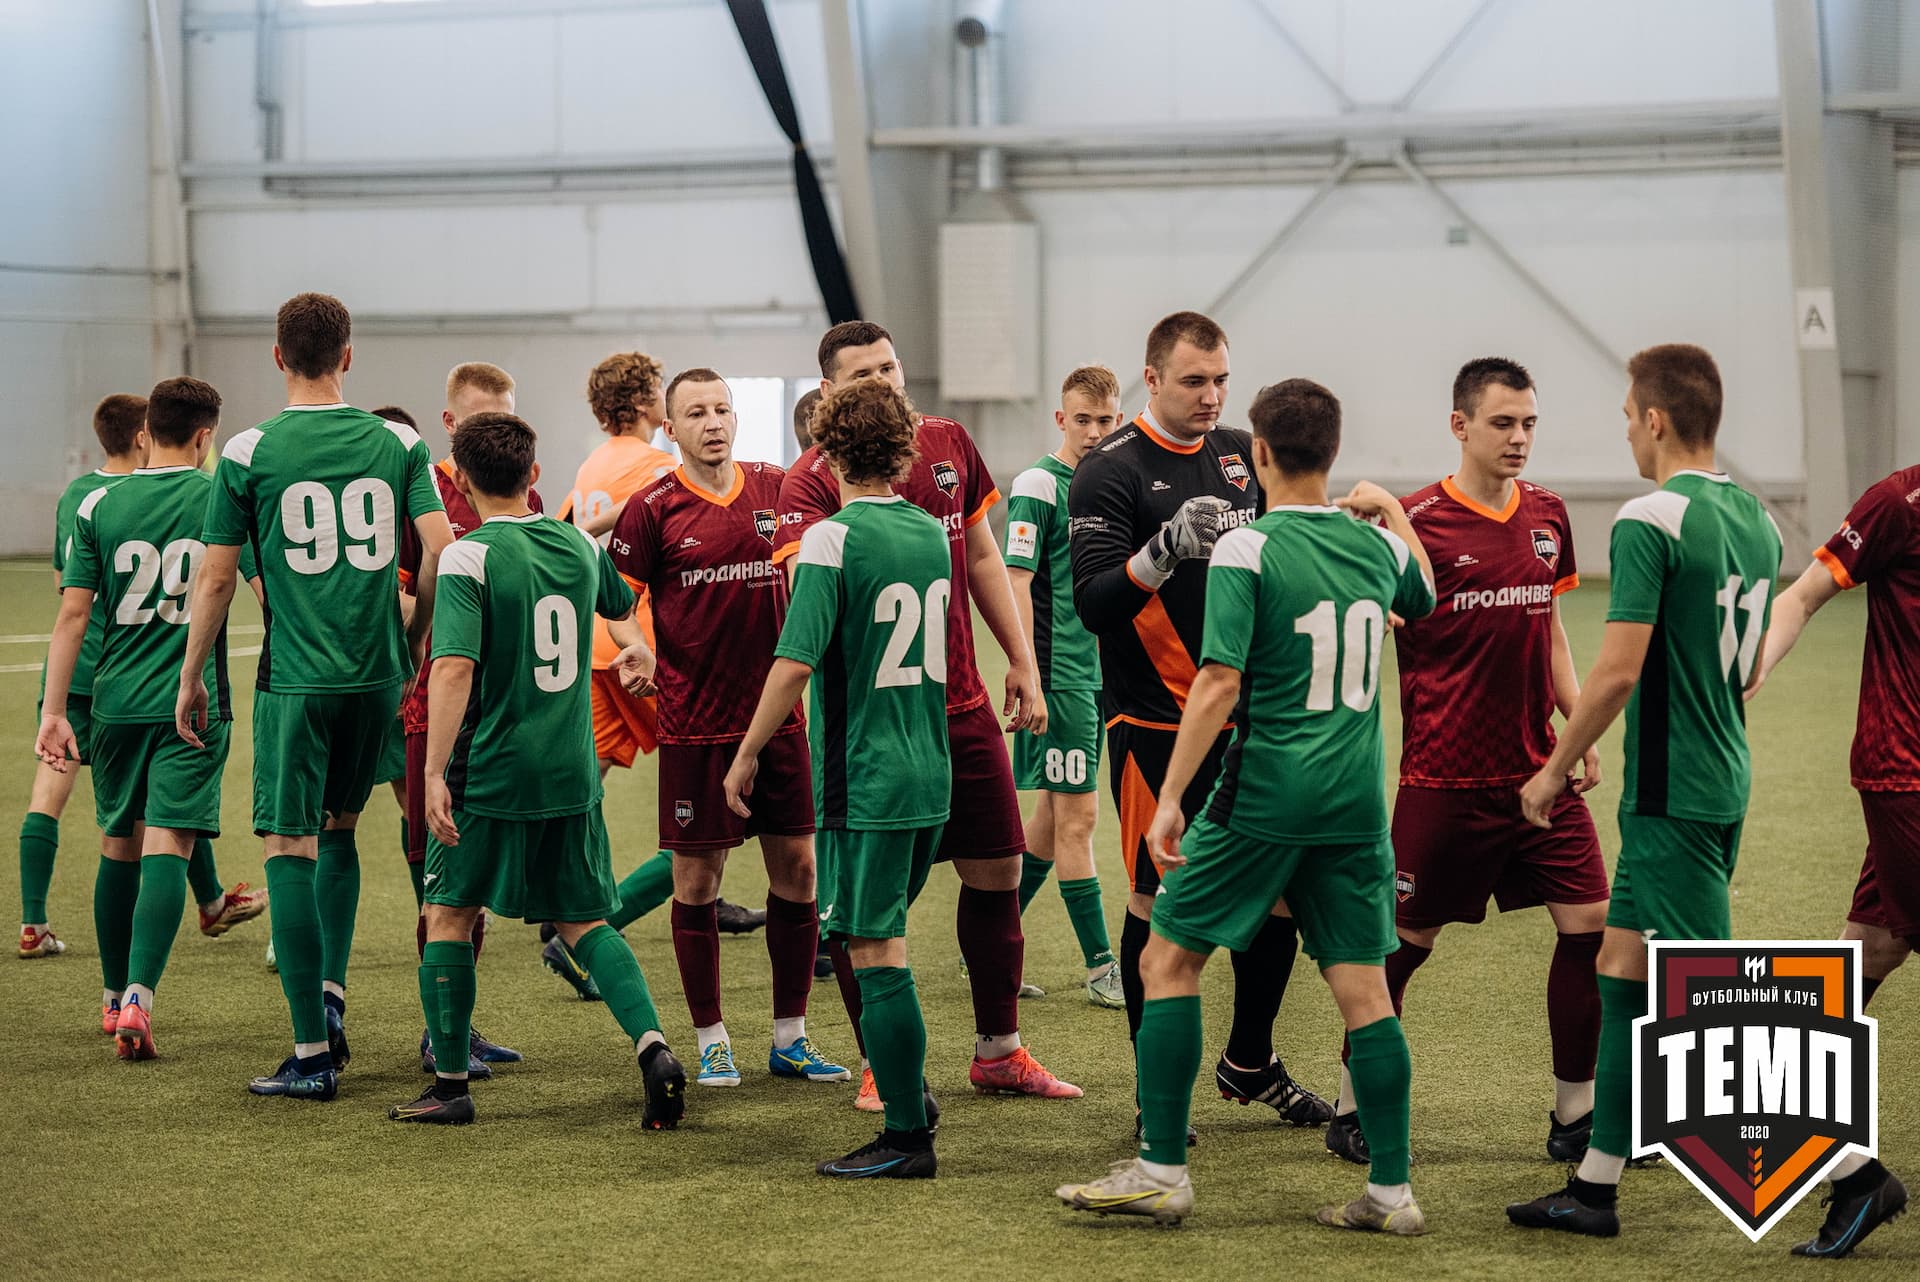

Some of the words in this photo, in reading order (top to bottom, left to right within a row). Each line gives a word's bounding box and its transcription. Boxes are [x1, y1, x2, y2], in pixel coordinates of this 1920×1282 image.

[936, 470, 958, 486] ТЕМП
[281, 477, 398, 574] 99
[114, 538, 207, 625] 29
[681, 560, 782, 588] ПРОДИНВЕ
[1453, 584, 1553, 612] ПРОДИНВЕС
[534, 595, 578, 692] 9
[874, 579, 951, 689] 20
[1295, 600, 1384, 712] 10
[1717, 574, 1771, 688] 11
[1046, 748, 1087, 785] 80
